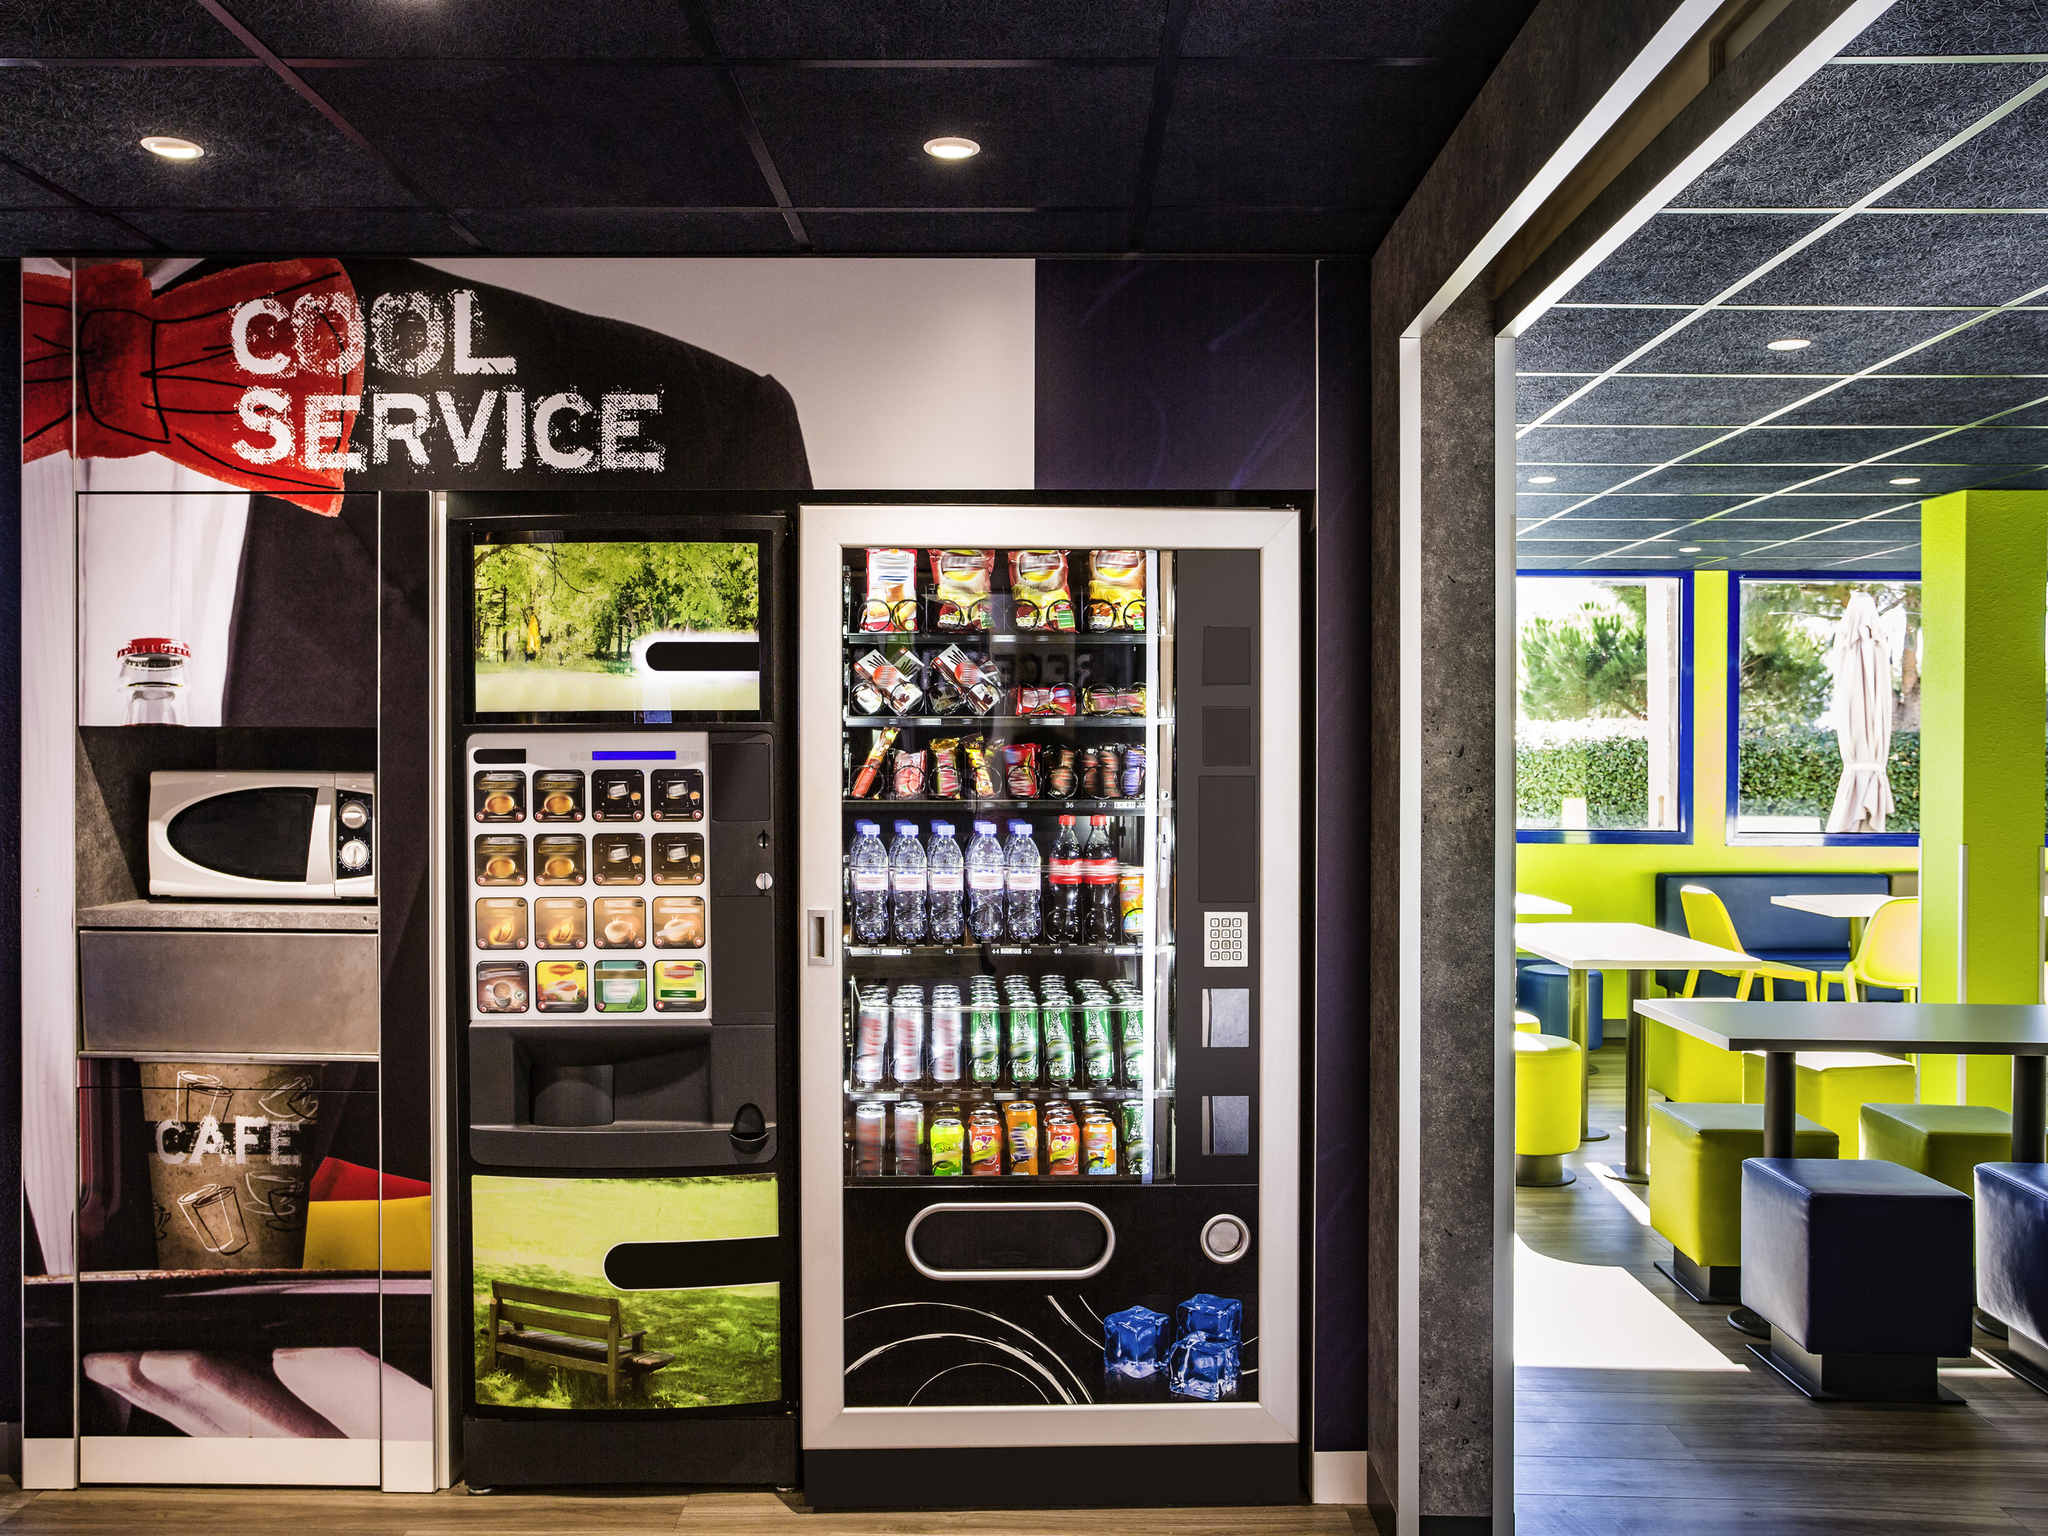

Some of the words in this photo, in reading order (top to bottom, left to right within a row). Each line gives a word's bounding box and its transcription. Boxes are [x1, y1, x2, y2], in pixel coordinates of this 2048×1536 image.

[227, 288, 519, 377] COOL
[231, 384, 667, 473] SERVICE
[155, 1115, 302, 1167] CAFE
